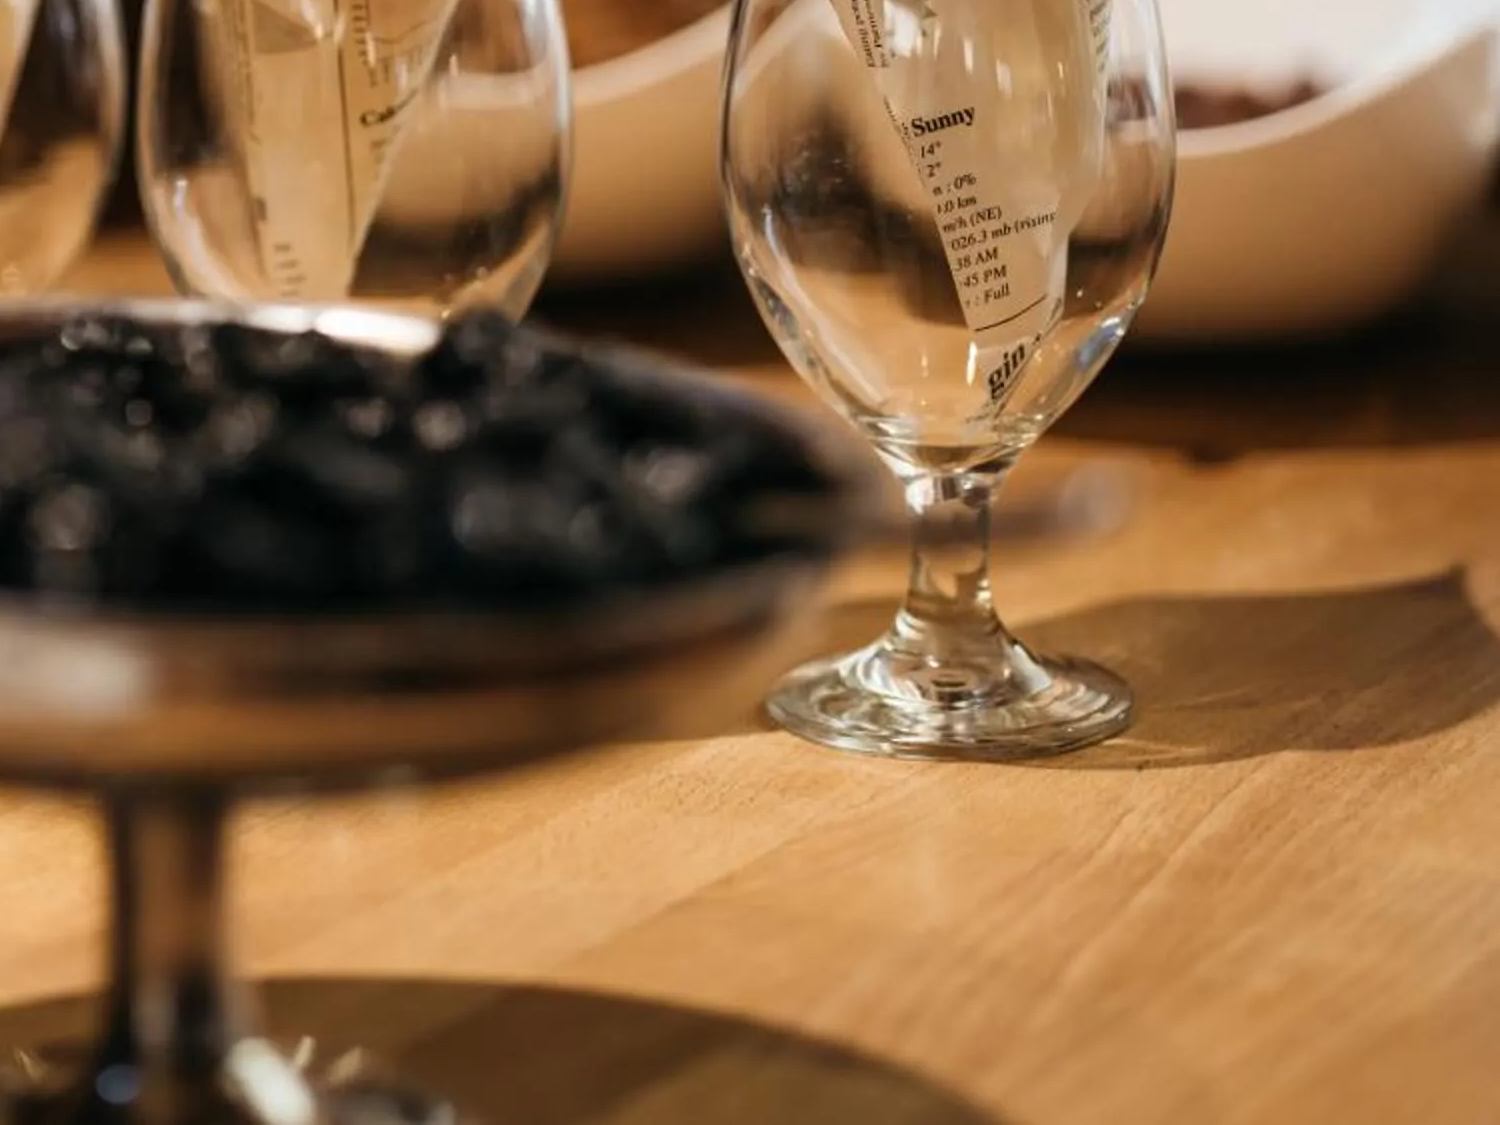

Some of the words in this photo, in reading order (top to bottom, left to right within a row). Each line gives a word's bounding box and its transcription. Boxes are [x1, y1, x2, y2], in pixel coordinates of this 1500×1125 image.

[910, 105, 976, 138] Sunny
[968, 205, 1003, 228] (NE)
[974, 245, 999, 266] AM
[983, 263, 1008, 284] PM
[983, 282, 1011, 304] Full
